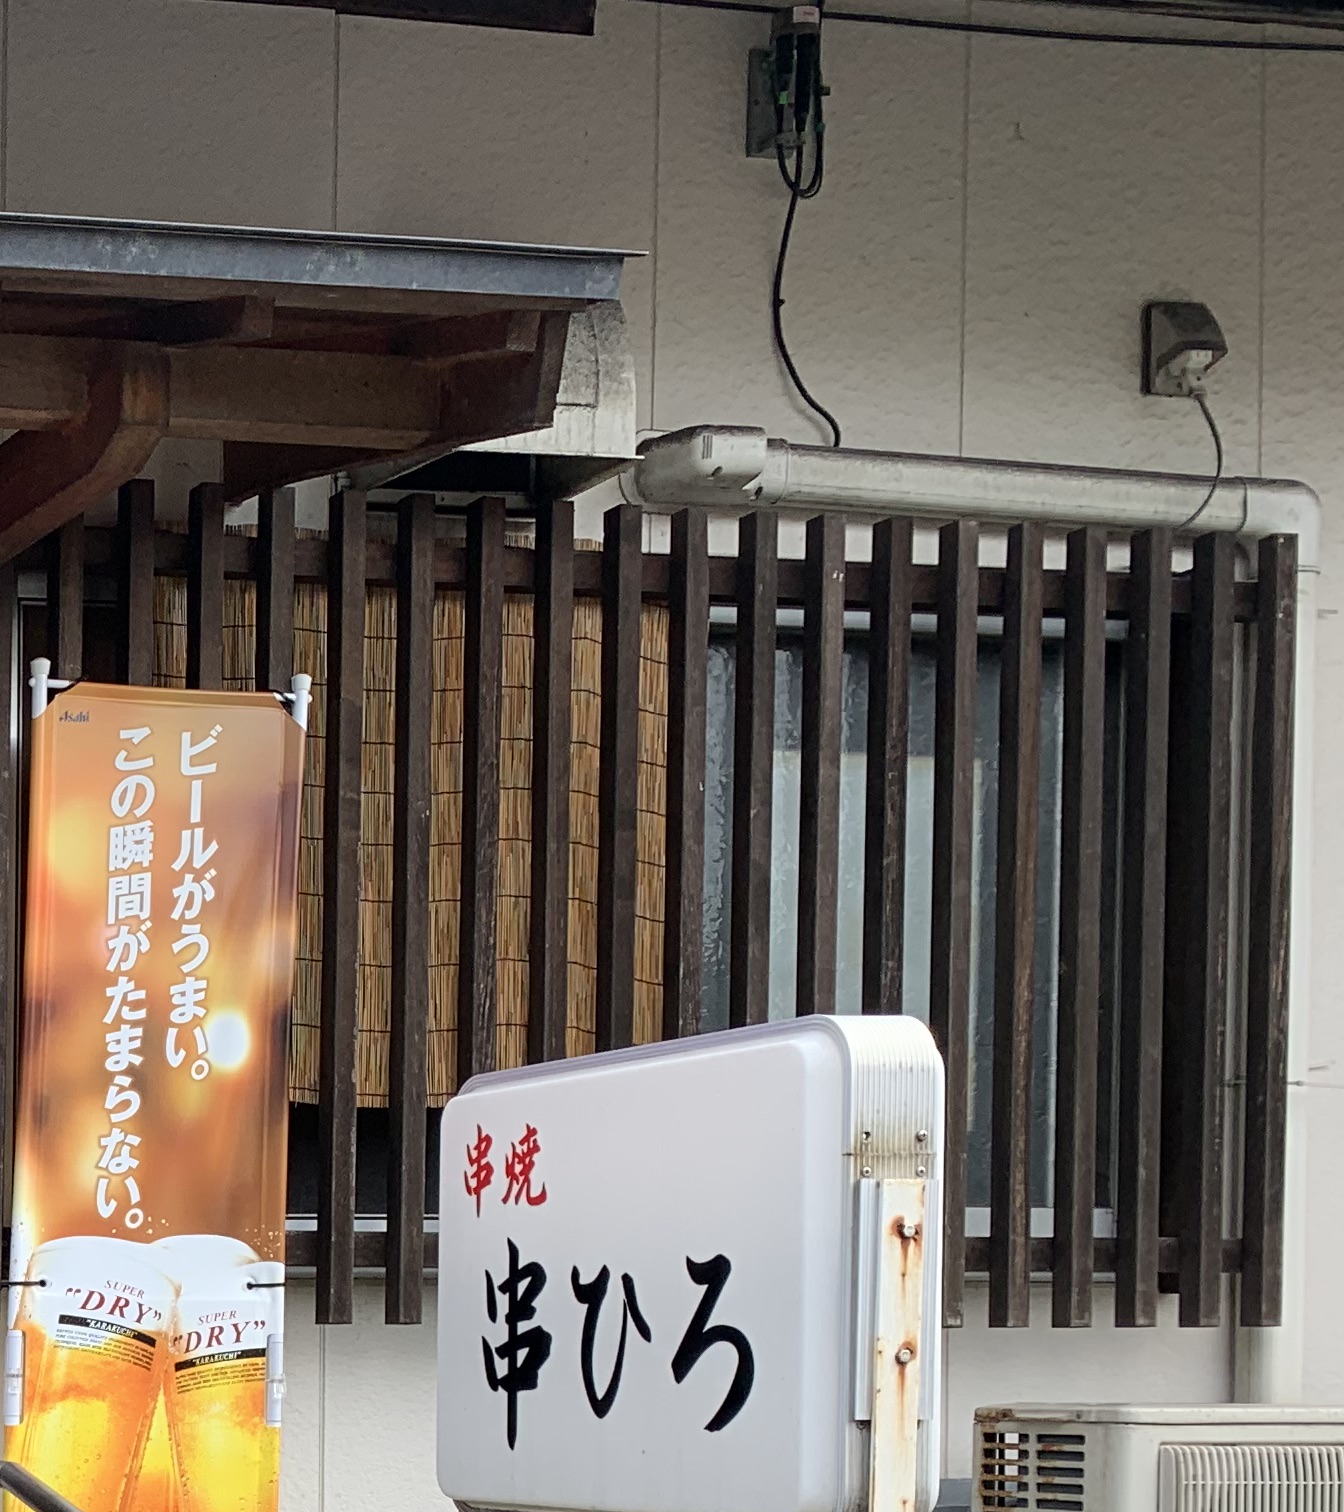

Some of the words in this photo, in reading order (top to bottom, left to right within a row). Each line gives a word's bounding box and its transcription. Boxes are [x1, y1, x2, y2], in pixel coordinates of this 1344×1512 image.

[95, 725, 156, 1230] この瞬間がたまらない。
[165, 723, 224, 1081] ビールがうまい。
[463, 1123, 548, 1218] 串焼
[104, 1279, 145, 1299] SUPER
[198, 1310, 237, 1325] SUPER
[481, 1236, 755, 1451] 串ひろ
